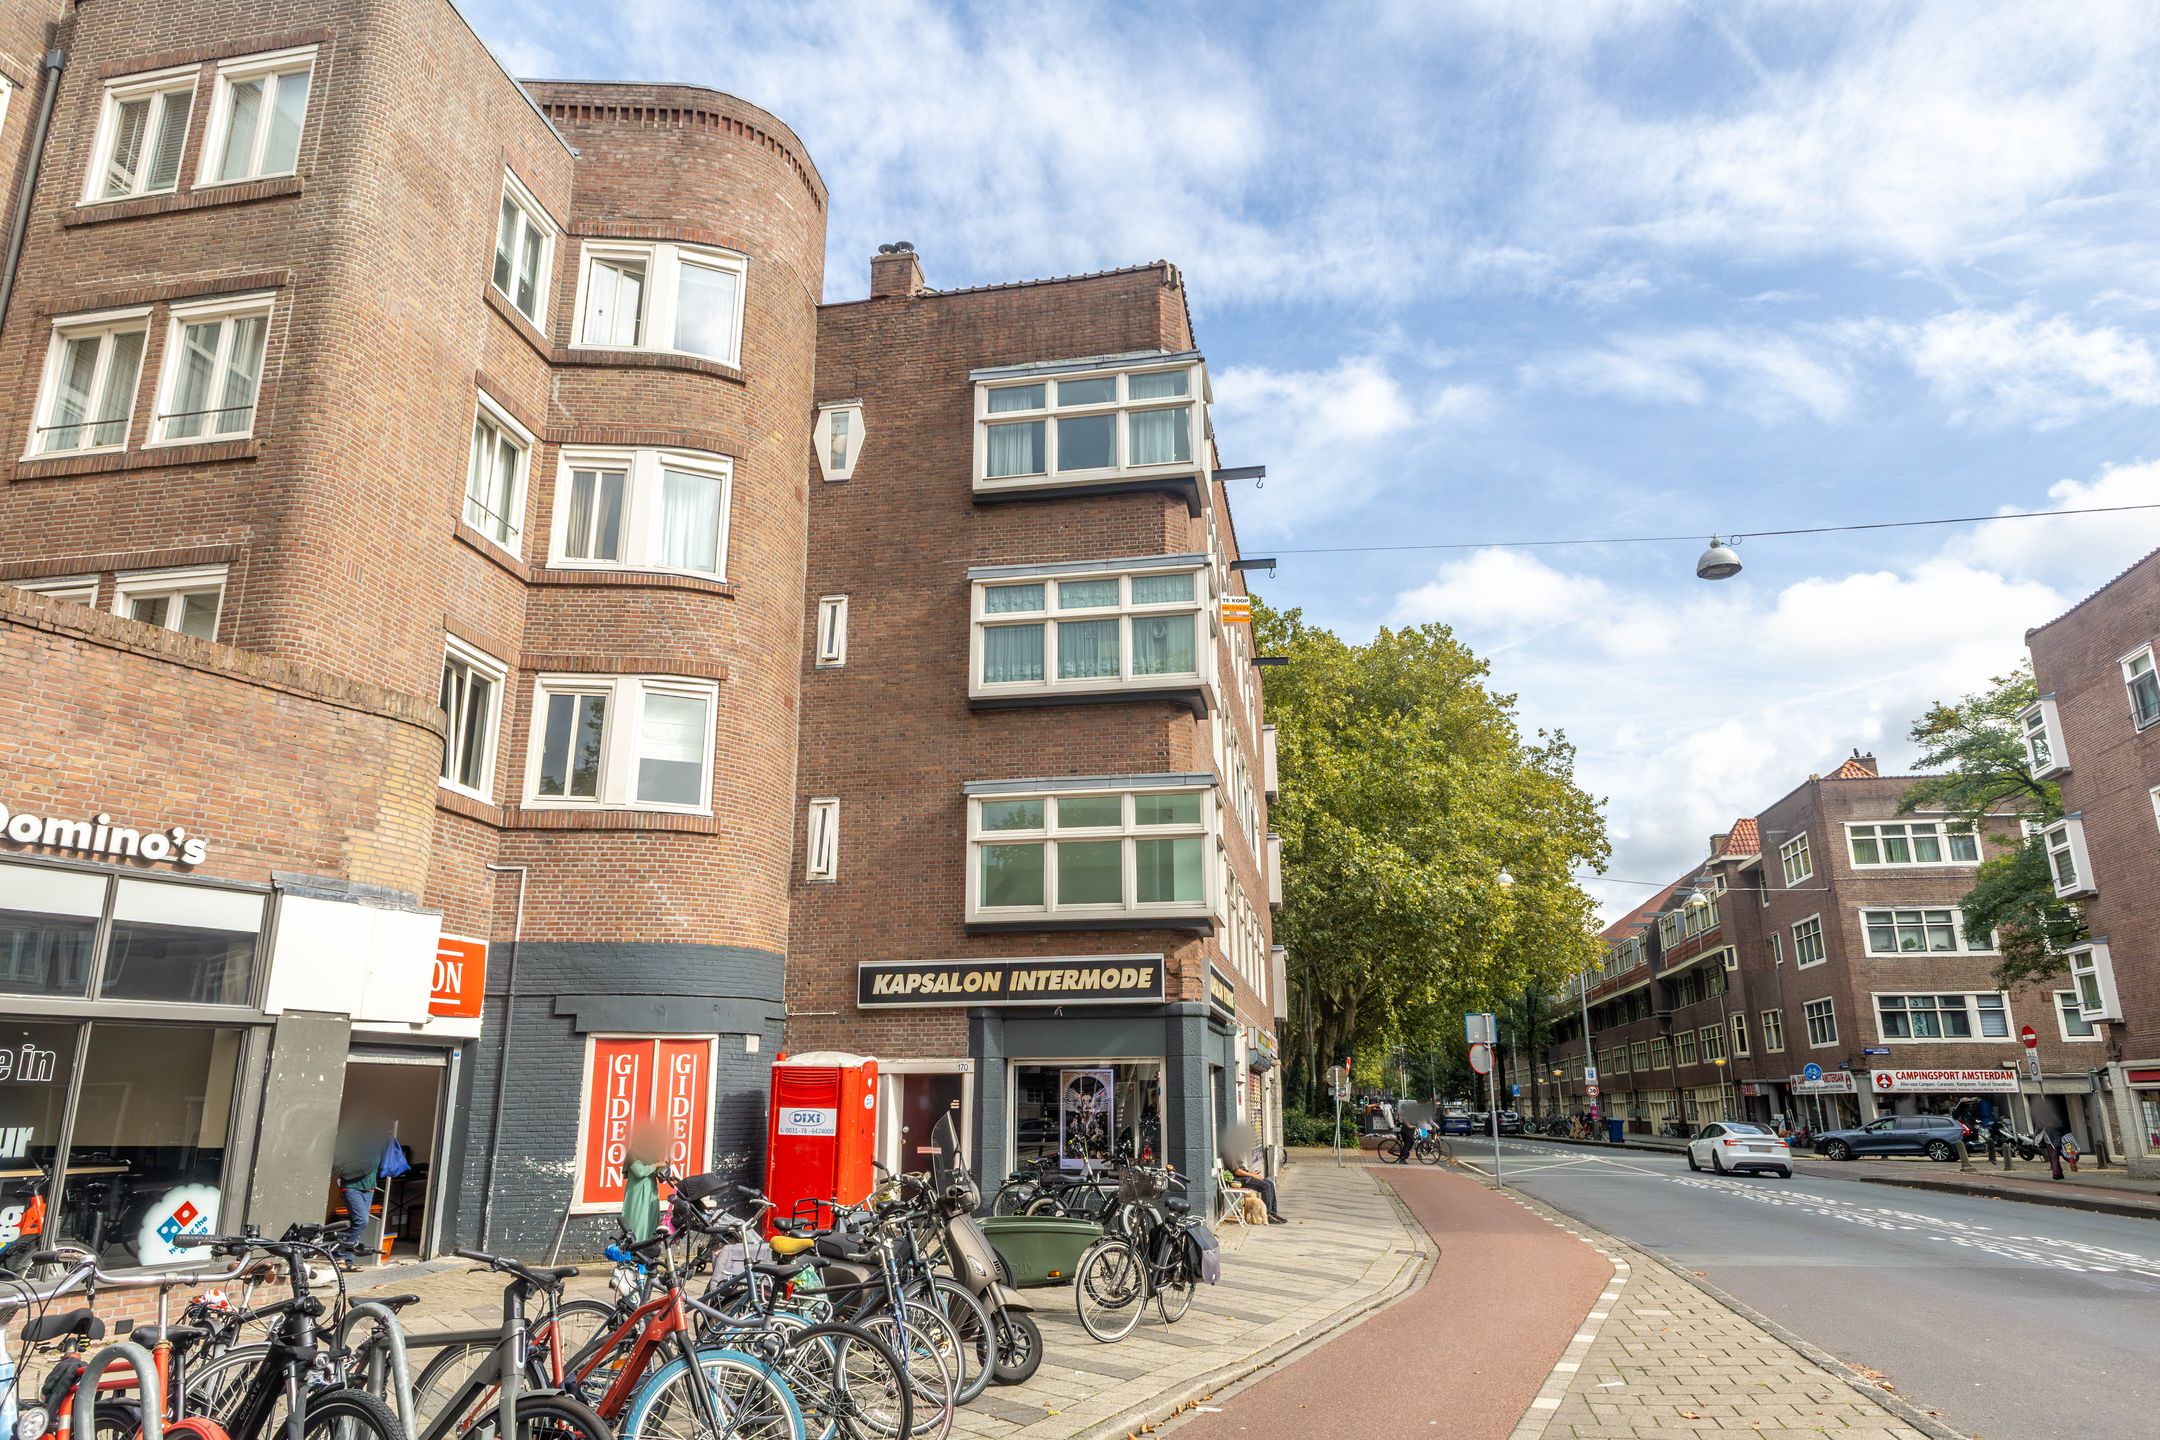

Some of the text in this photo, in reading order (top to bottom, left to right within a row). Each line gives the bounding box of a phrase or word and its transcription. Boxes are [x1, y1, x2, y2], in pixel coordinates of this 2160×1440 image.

[872, 967, 1154, 995] KAPSALON INTERMODE
[958, 1063, 969, 1071] 170
[1895, 1071, 2014, 1080] CAMPINGSPORT AMSTERDAM
